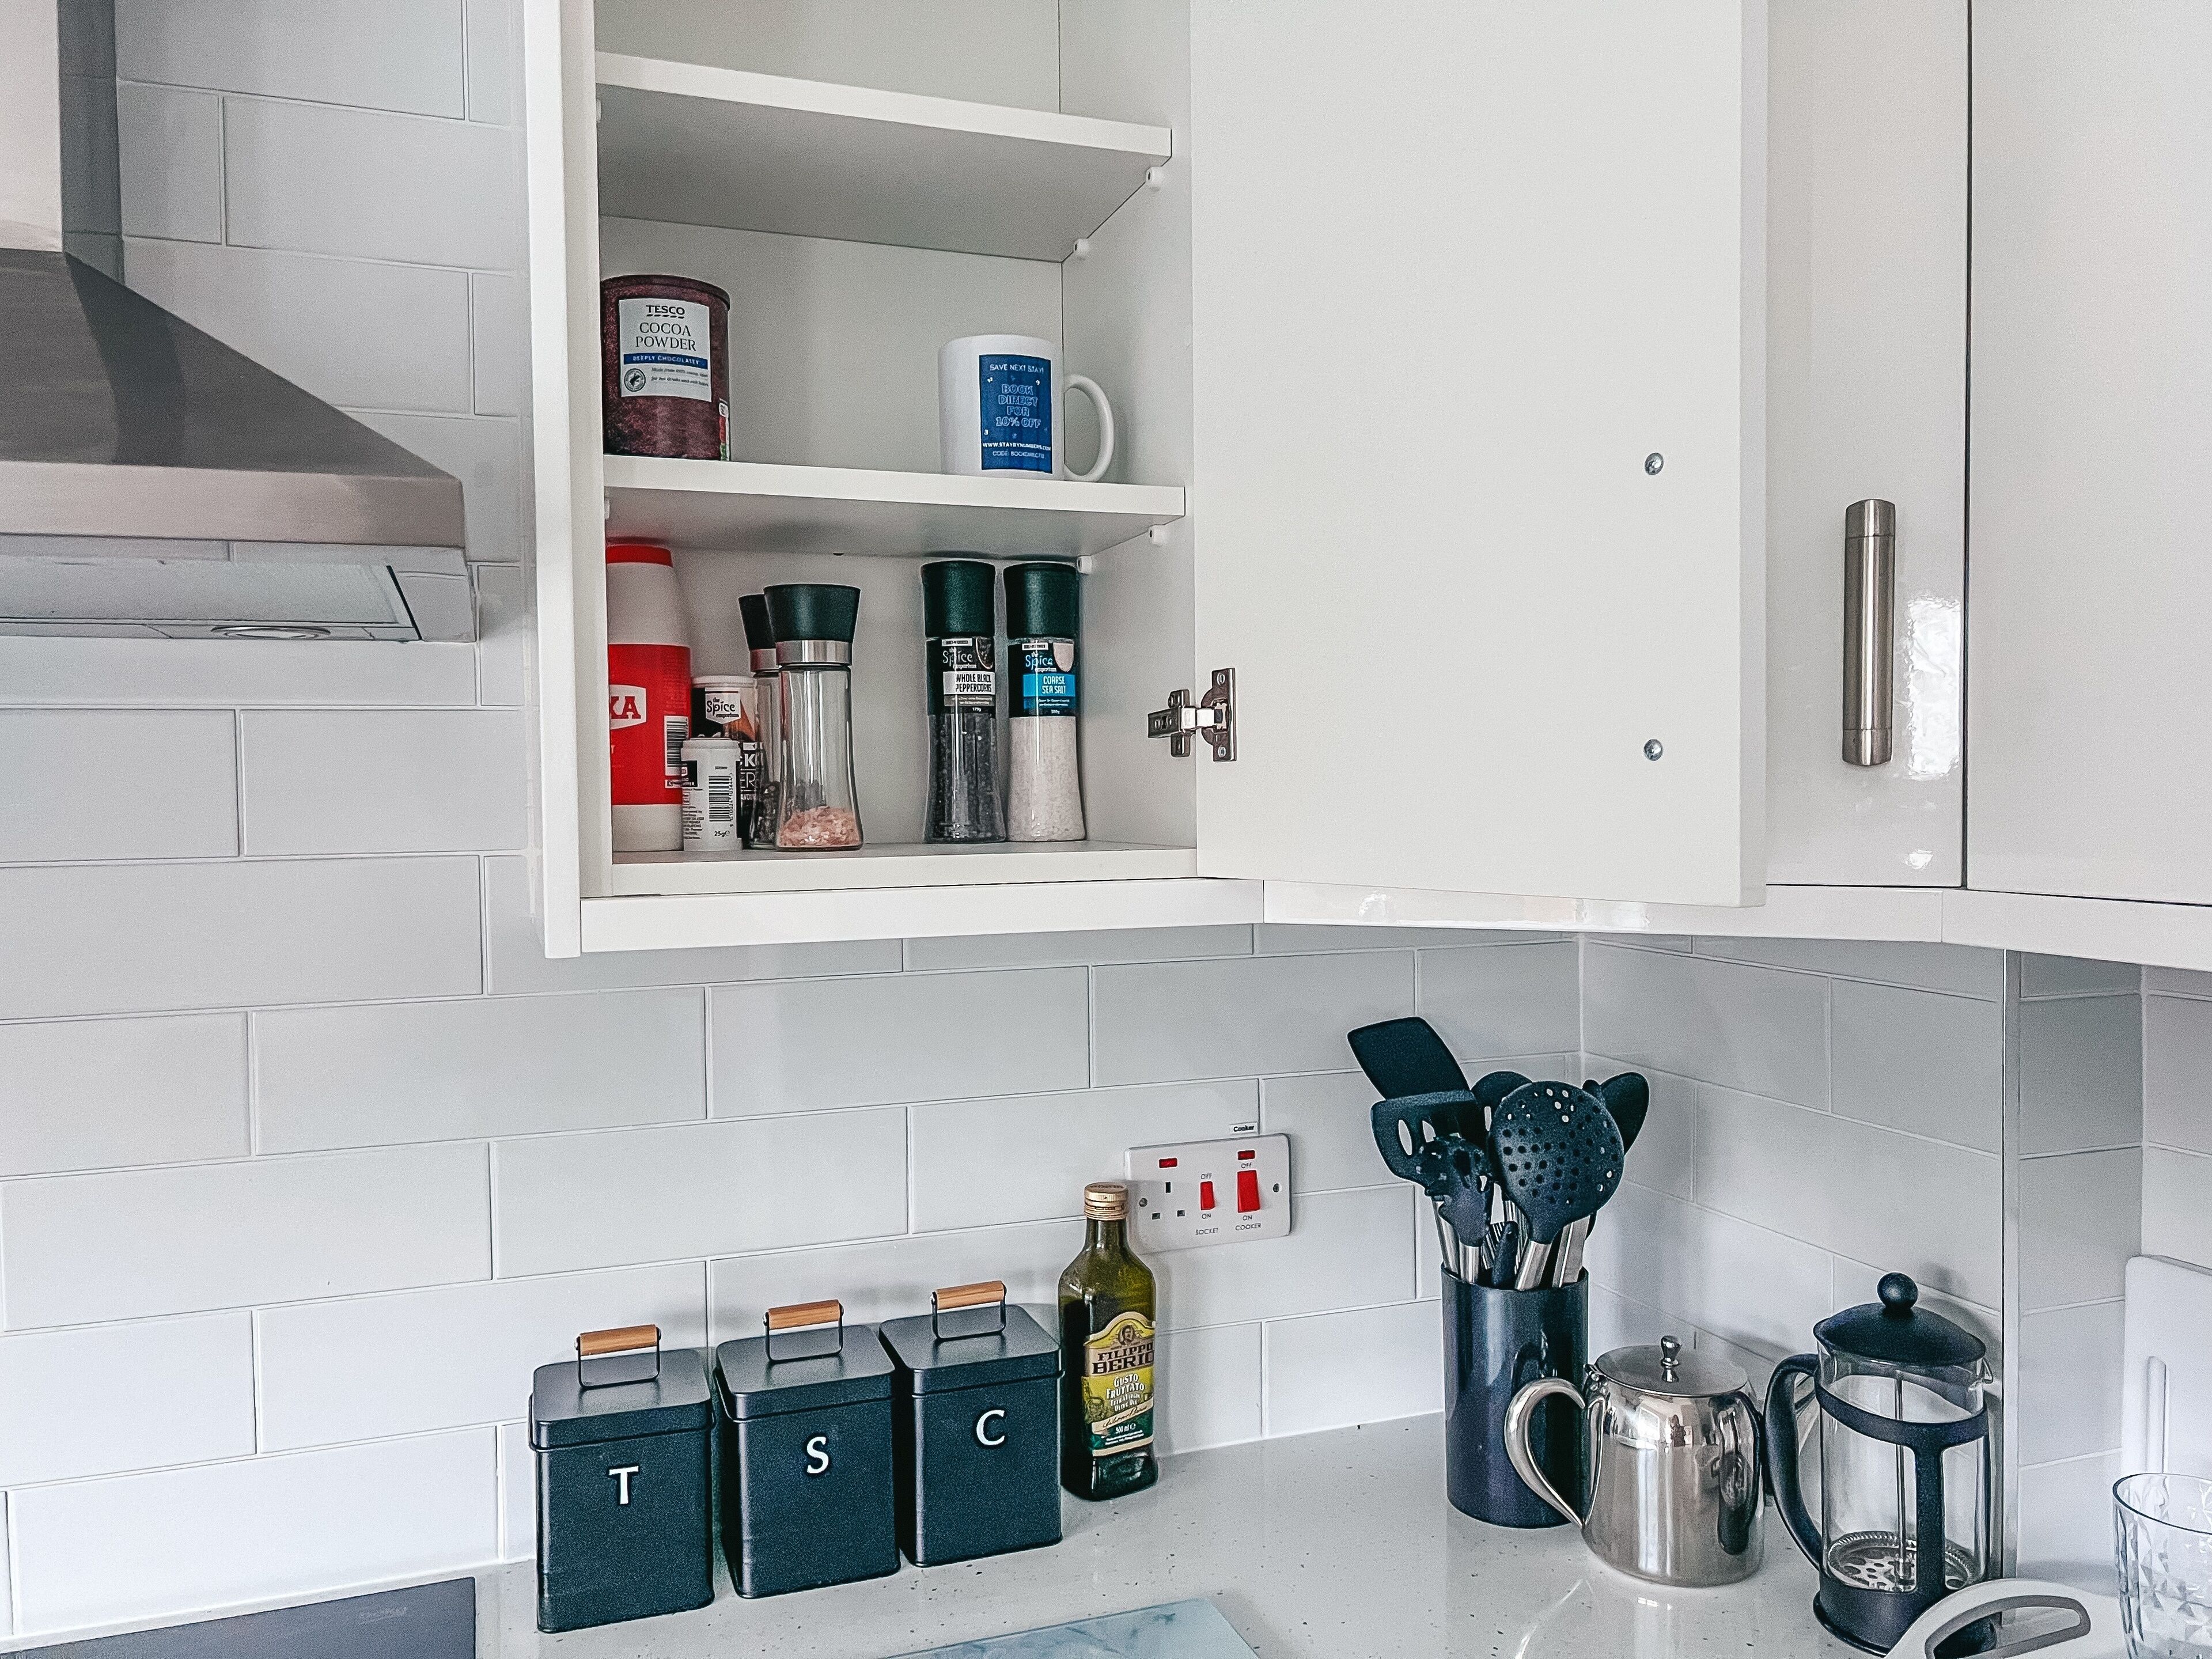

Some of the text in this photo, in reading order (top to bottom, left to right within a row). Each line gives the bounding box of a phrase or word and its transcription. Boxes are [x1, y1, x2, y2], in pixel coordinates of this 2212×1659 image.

[646, 305, 685, 315] TESCO
[639, 322, 691, 337] COCOA
[635, 336, 696, 351] POWDER
[1002, 384, 1033, 396] BOOK
[998, 395, 1039, 407] DIRECT
[1007, 406, 1030, 417] FOR
[995, 416, 1041, 429] 10% OFF
[943, 650, 973, 666] Spice
[1025, 654, 1053, 671] Spice
[956, 674, 976, 683] WHOLE
[1043, 676, 1065, 684] COARSE
[1041, 685, 1053, 694] SEA
[706, 700, 735, 717] Spice
[1235, 1222, 1262, 1231] COOKER
[1097, 1342, 1153, 1361] FILIPPO
[1113, 1373, 1139, 1388] GUSTO
[1106, 1382, 1145, 1400] FRUTTATO
[976, 1410, 1005, 1446] C
[806, 1436, 830, 1474] S
[608, 1465, 639, 1505] T
